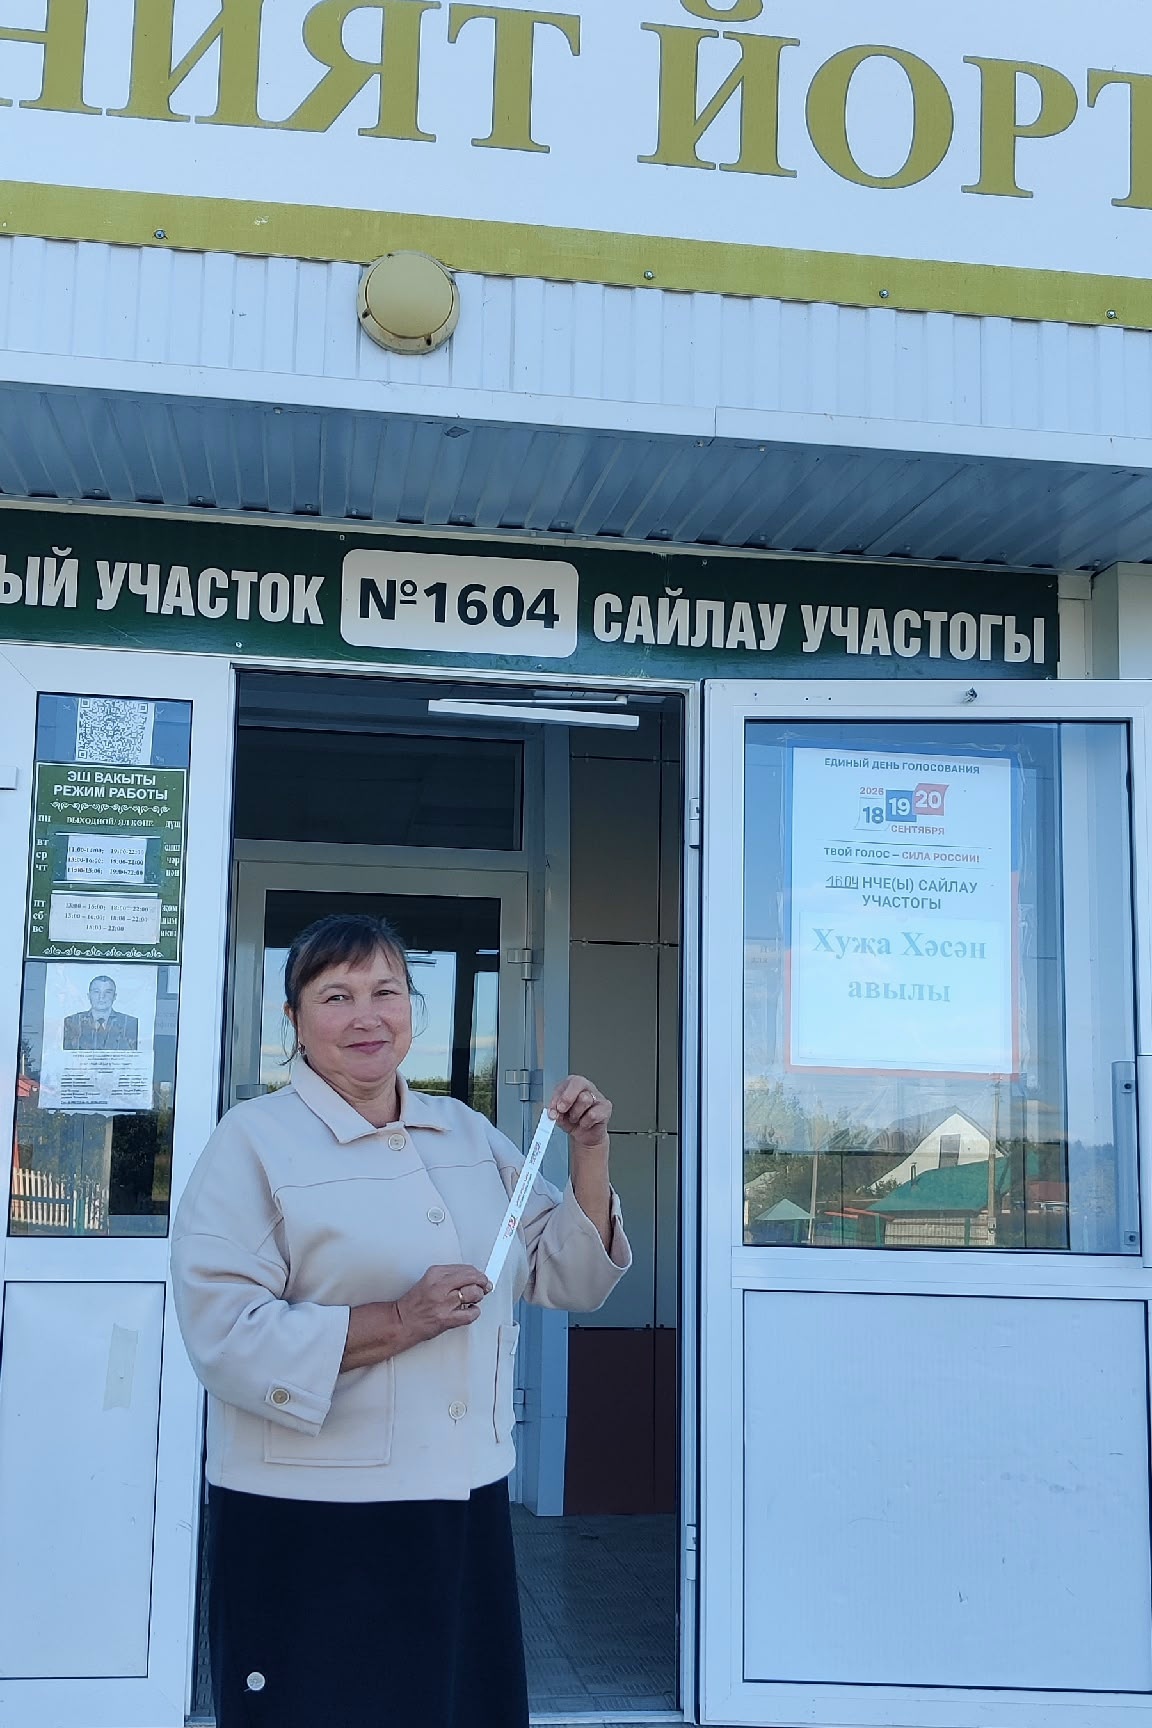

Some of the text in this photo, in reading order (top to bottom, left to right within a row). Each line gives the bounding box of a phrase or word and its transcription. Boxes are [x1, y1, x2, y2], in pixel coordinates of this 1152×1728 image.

[96, 560, 325, 625] УЧАСТОК
[358, 577, 560, 629] №1604
[593, 586, 787, 651] САЙЛАУ
[800, 604, 1045, 664] УЧАСТОГЫ
[825, 757, 980, 774] ЕДИНЫЙ ДЕНЬ ГОЛОСОВАНИЯ
[67, 771, 156, 785] ЭШ ВАКЫТЫ
[53, 784, 168, 800] РЕЖИМ РАБОТЫ
[862, 790, 942, 824] 18 19 20
[891, 824, 945, 835] СЕНТЯБРЯ
[824, 847, 852, 857] ТВОЙ
[855, 848, 890, 859] ГОЛОС
[902, 851, 931, 861] СИЛА
[933, 853, 980, 863] РОССИИ!
[862, 876, 914, 893] НЧЕ(Ы)
[918, 877, 978, 894] САЙЛАУ
[862, 894, 941, 910] УЧАСТОГЫ
[900, 931, 987, 960] Хәсән
[848, 980, 951, 1002] авылы
